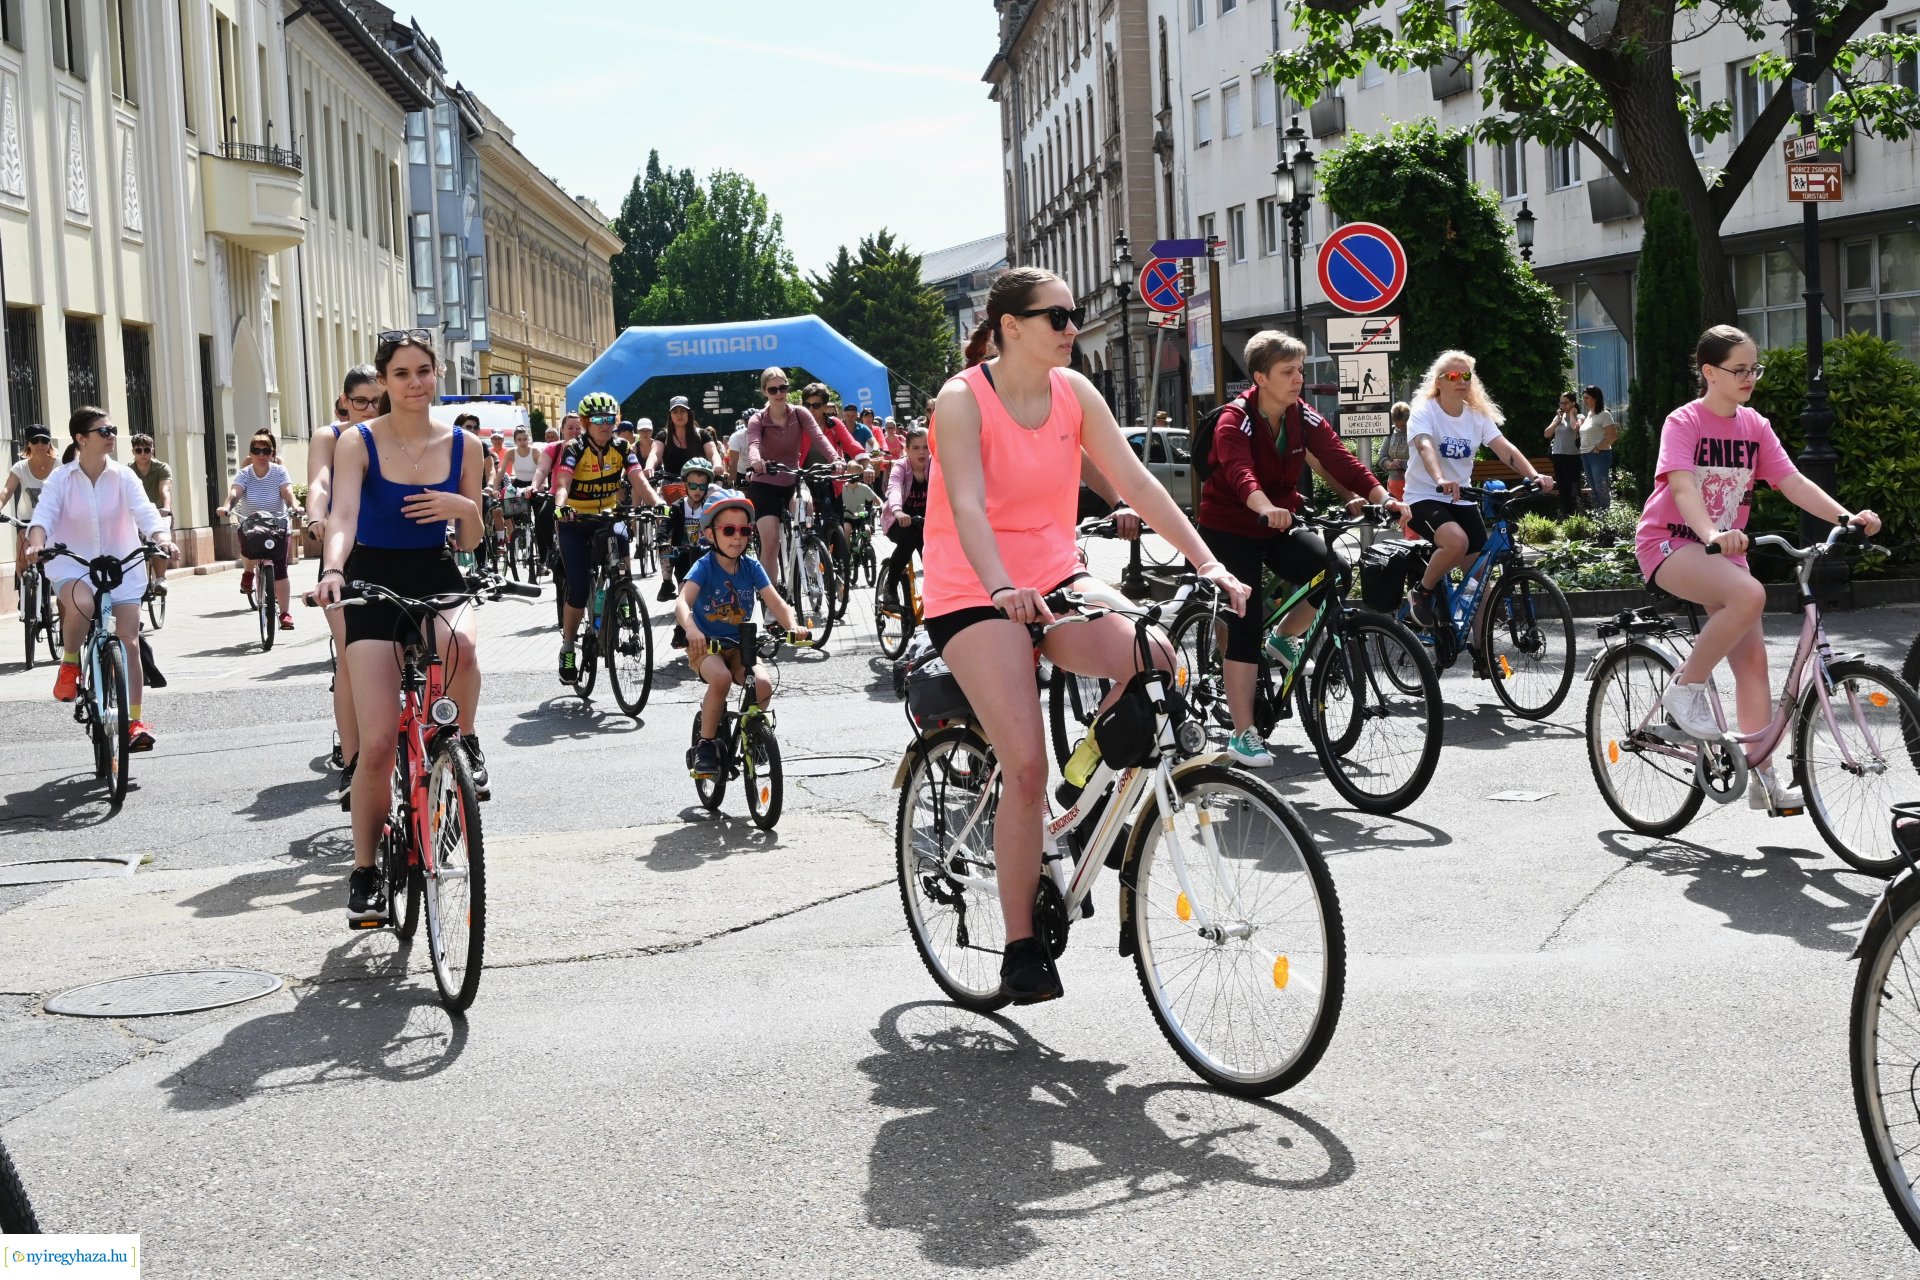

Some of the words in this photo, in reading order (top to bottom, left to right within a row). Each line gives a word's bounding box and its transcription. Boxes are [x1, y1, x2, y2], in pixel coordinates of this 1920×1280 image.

[1811, 166, 1837, 174] ZSIGMOND
[666, 334, 778, 357] SHIMANO
[1443, 436, 1471, 447] CRAZY
[1445, 444, 1466, 457] 5K
[1693, 437, 1760, 469] ENLEY
